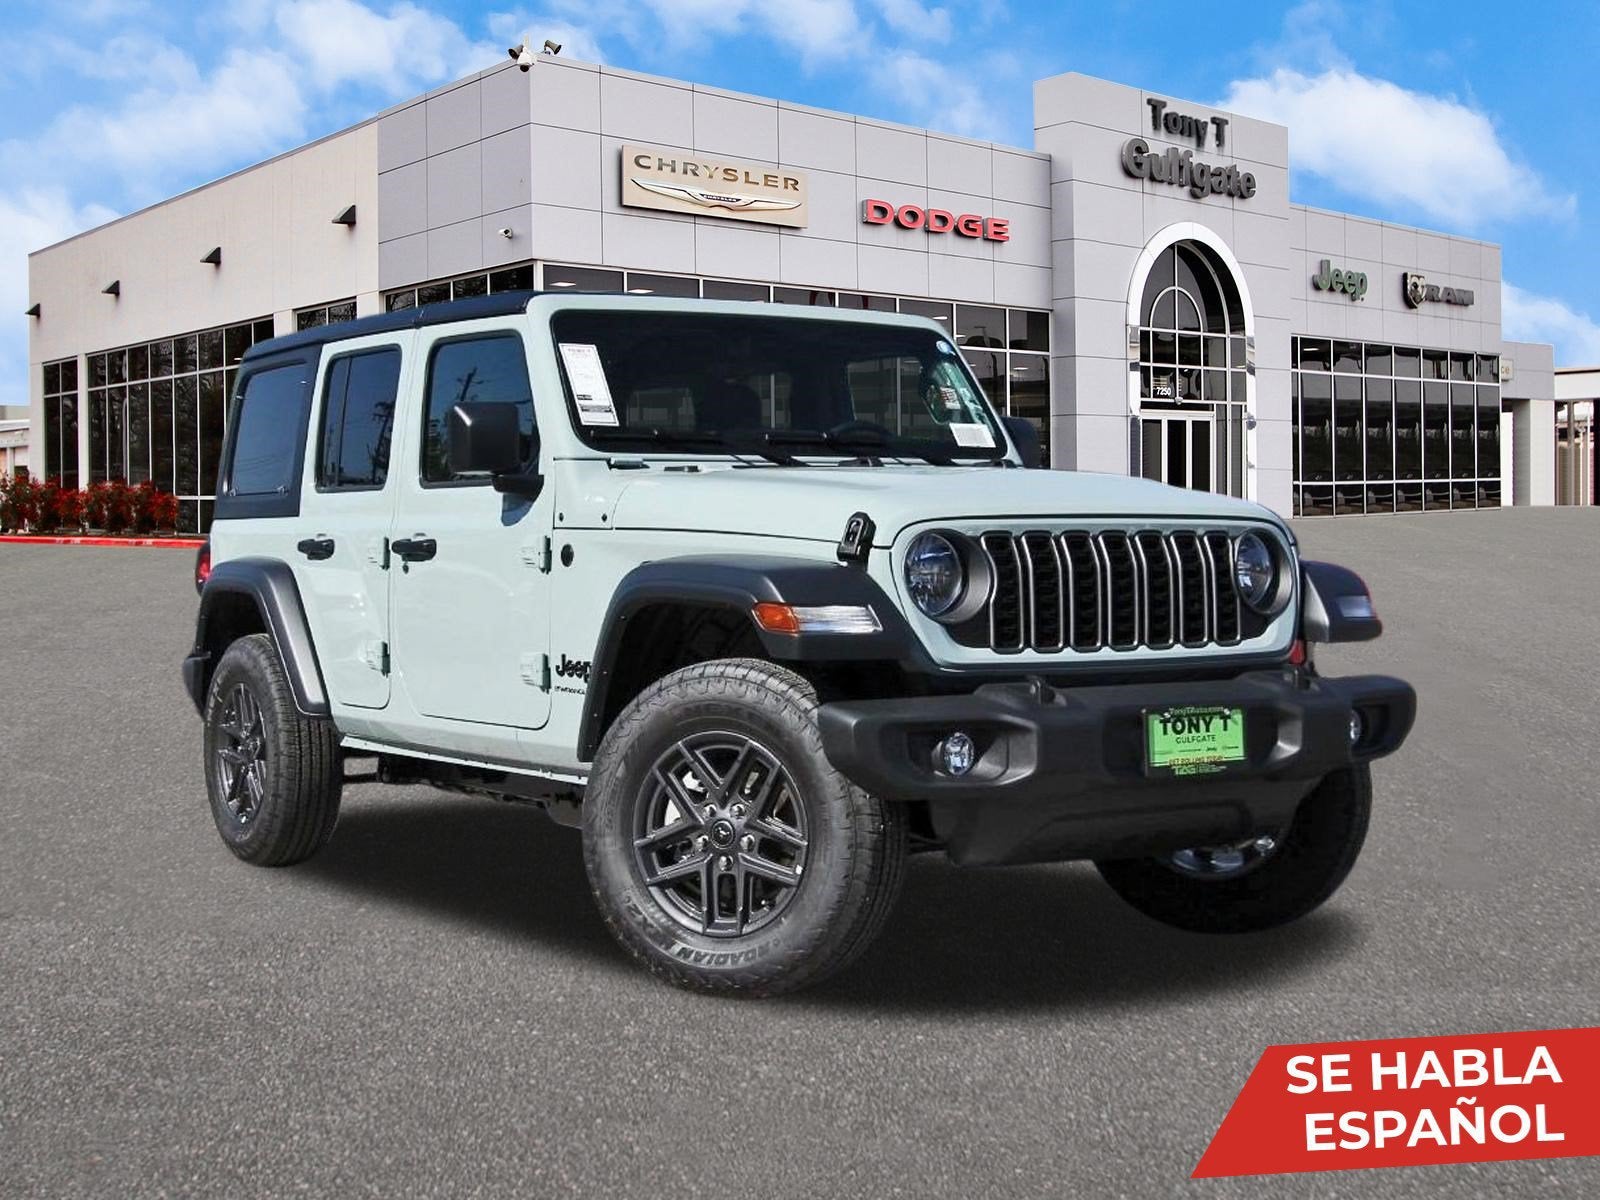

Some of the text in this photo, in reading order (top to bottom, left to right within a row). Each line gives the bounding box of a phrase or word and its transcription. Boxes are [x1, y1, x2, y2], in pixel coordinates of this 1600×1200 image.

[1147, 98, 1229, 147] Tony T
[634, 154, 800, 191] CHRYSLER
[1121, 138, 1256, 199] Gulfgate
[862, 199, 1010, 242] DODGE
[1312, 259, 1368, 302] Jeep
[1425, 284, 1474, 306] RAM
[1156, 386, 1172, 396] 7250
[555, 653, 591, 684] Jeep
[1160, 714, 1231, 736] TONY T
[1175, 735, 1216, 744] GULFGATE
